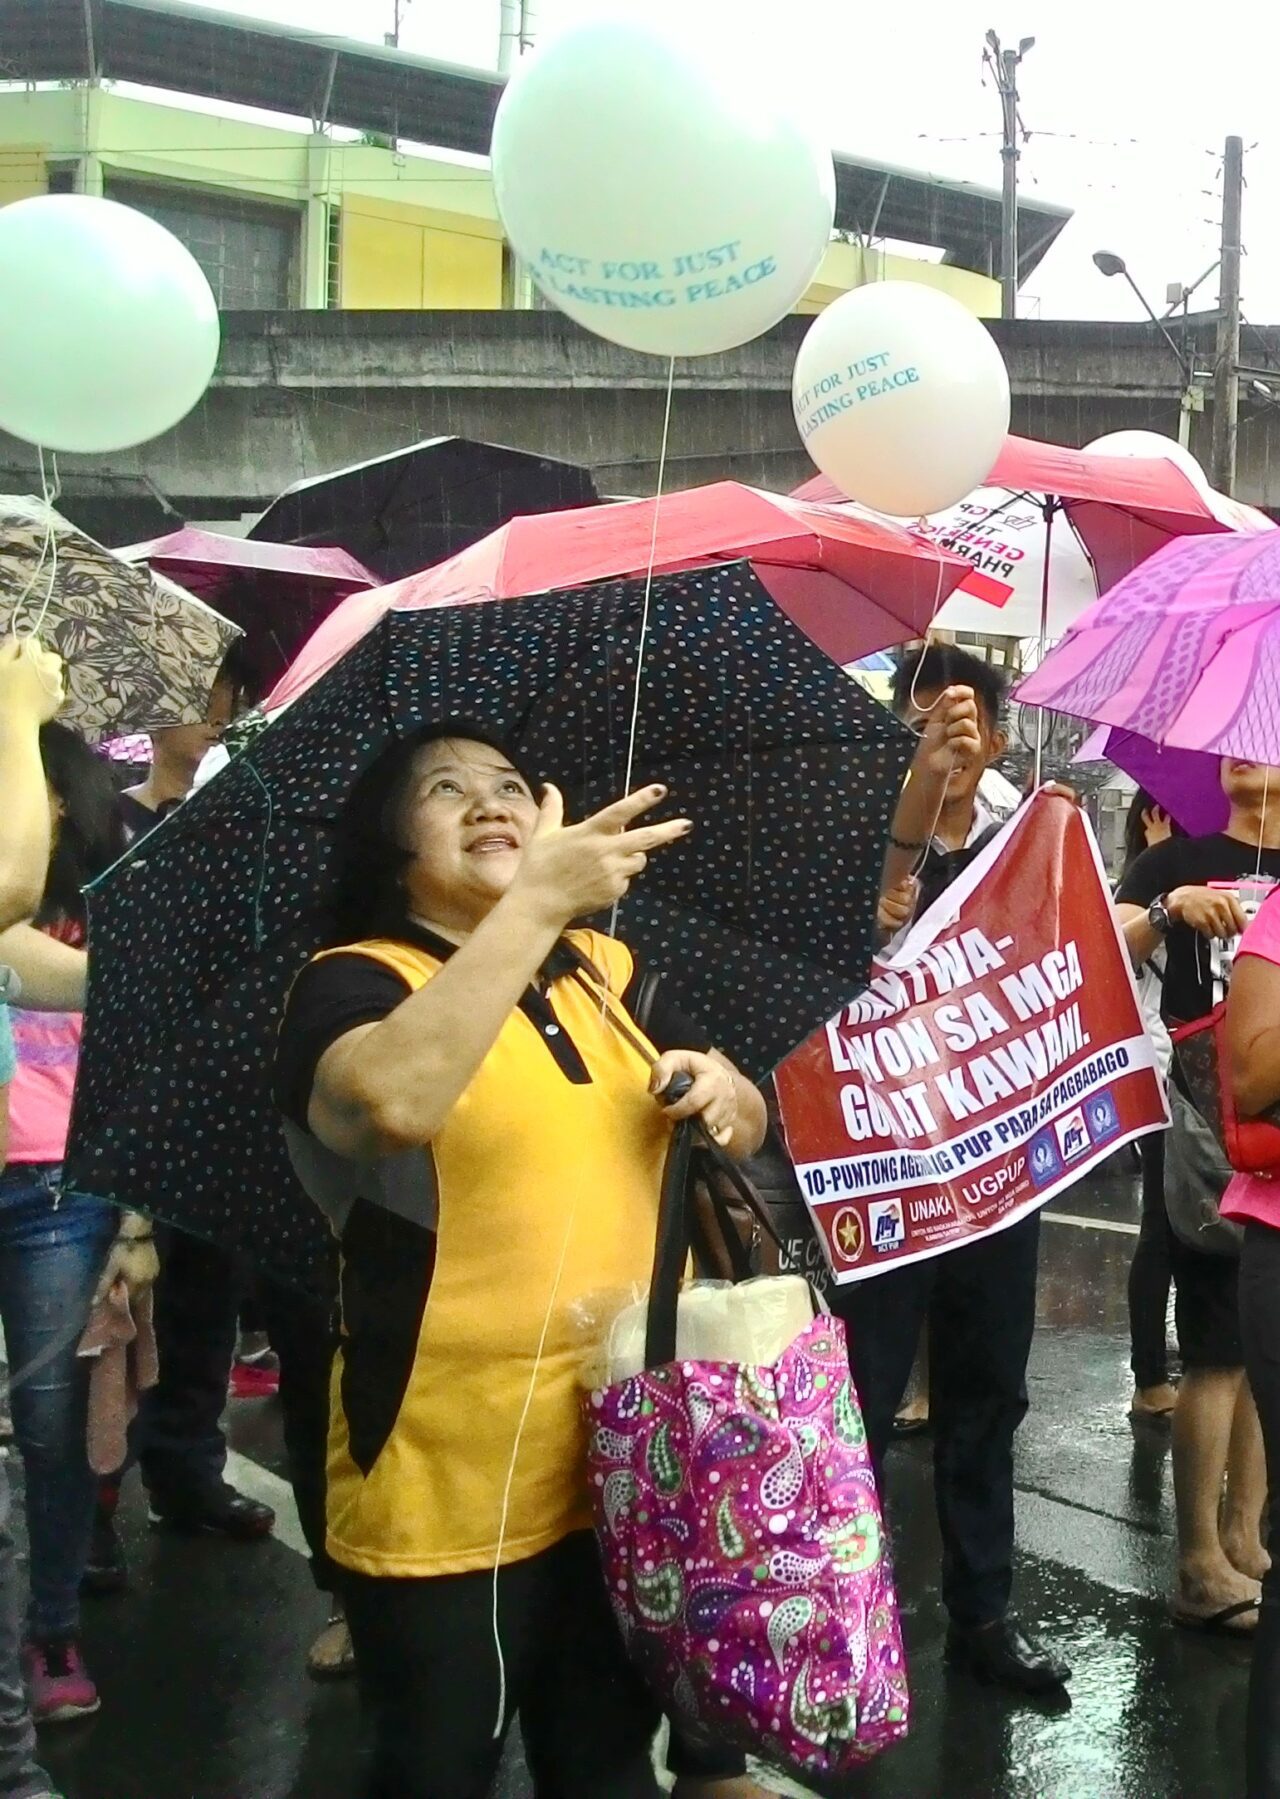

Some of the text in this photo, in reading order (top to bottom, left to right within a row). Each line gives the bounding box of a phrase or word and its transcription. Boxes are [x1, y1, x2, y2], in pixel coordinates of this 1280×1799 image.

[540, 240, 741, 282] ACT FOR JUST
[550, 275, 676, 308] LASTING
[686, 255, 777, 303] PEACE
[813, 373, 842, 398] FOR
[847, 351, 890, 380] JUST
[856, 367, 920, 402] PEACE
[934, 991, 1009, 1052] SA
[998, 940, 1084, 1022] MGA
[934, 1002, 1091, 1121] KAWANI.
[803, 1156, 898, 1197] 10-PUNTONG
[951, 1130, 995, 1165] PUP
[995, 1104, 1038, 1144] PARA
[1039, 1092, 1053, 1120] SA
[1053, 1047, 1129, 1109] PAGBABAGO
[962, 1157, 1025, 1204] UGPUP
